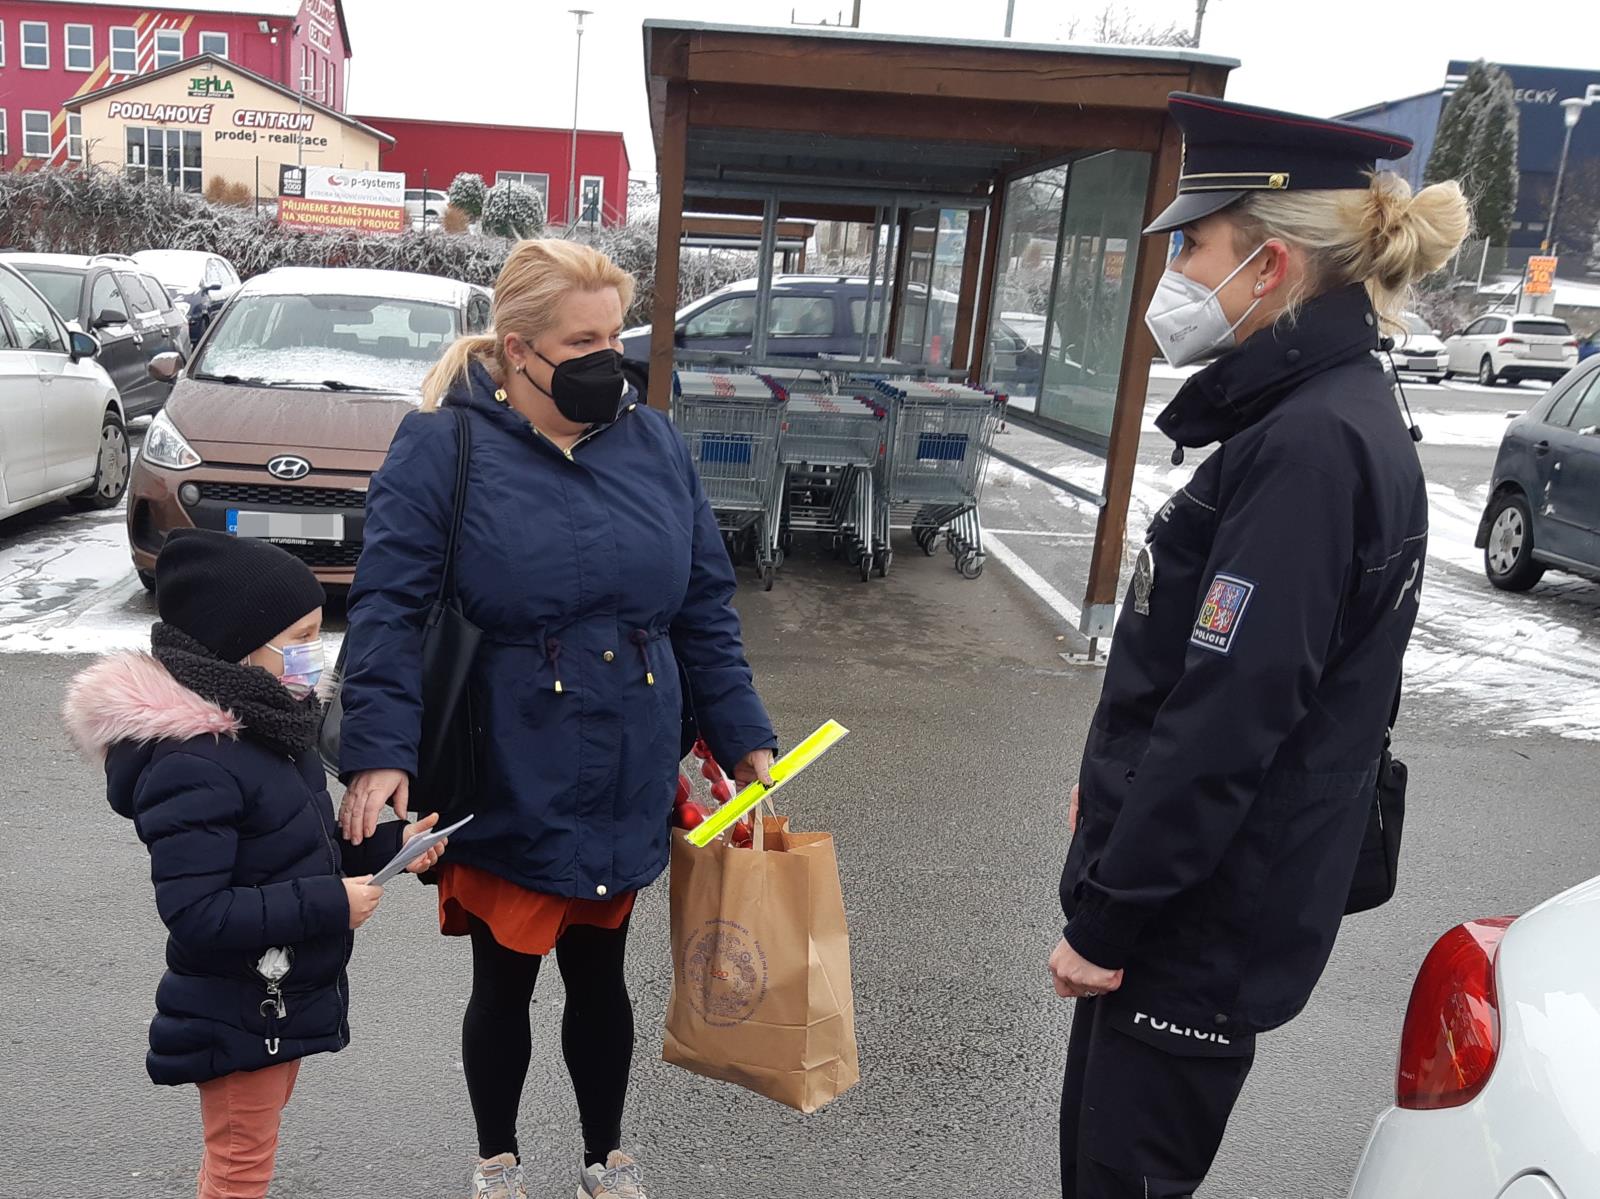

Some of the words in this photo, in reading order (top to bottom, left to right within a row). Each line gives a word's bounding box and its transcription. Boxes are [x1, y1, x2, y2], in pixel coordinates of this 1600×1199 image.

[188, 75, 234, 93] JEHLA
[1514, 87, 1559, 105] ECKÝ
[108, 101, 214, 124] PODLAHOVÉ
[233, 109, 314, 131] CENTRUM
[215, 129, 257, 144] prodej
[268, 132, 328, 147] realizace
[351, 177, 401, 190] p-systems
[282, 200, 329, 213] PŘIJMEME
[330, 202, 400, 219] ZAMĚSTNANCE
[282, 211, 295, 220] NA
[363, 220, 400, 230] PROVOZ
[1194, 629, 1227, 646] POLICIE
